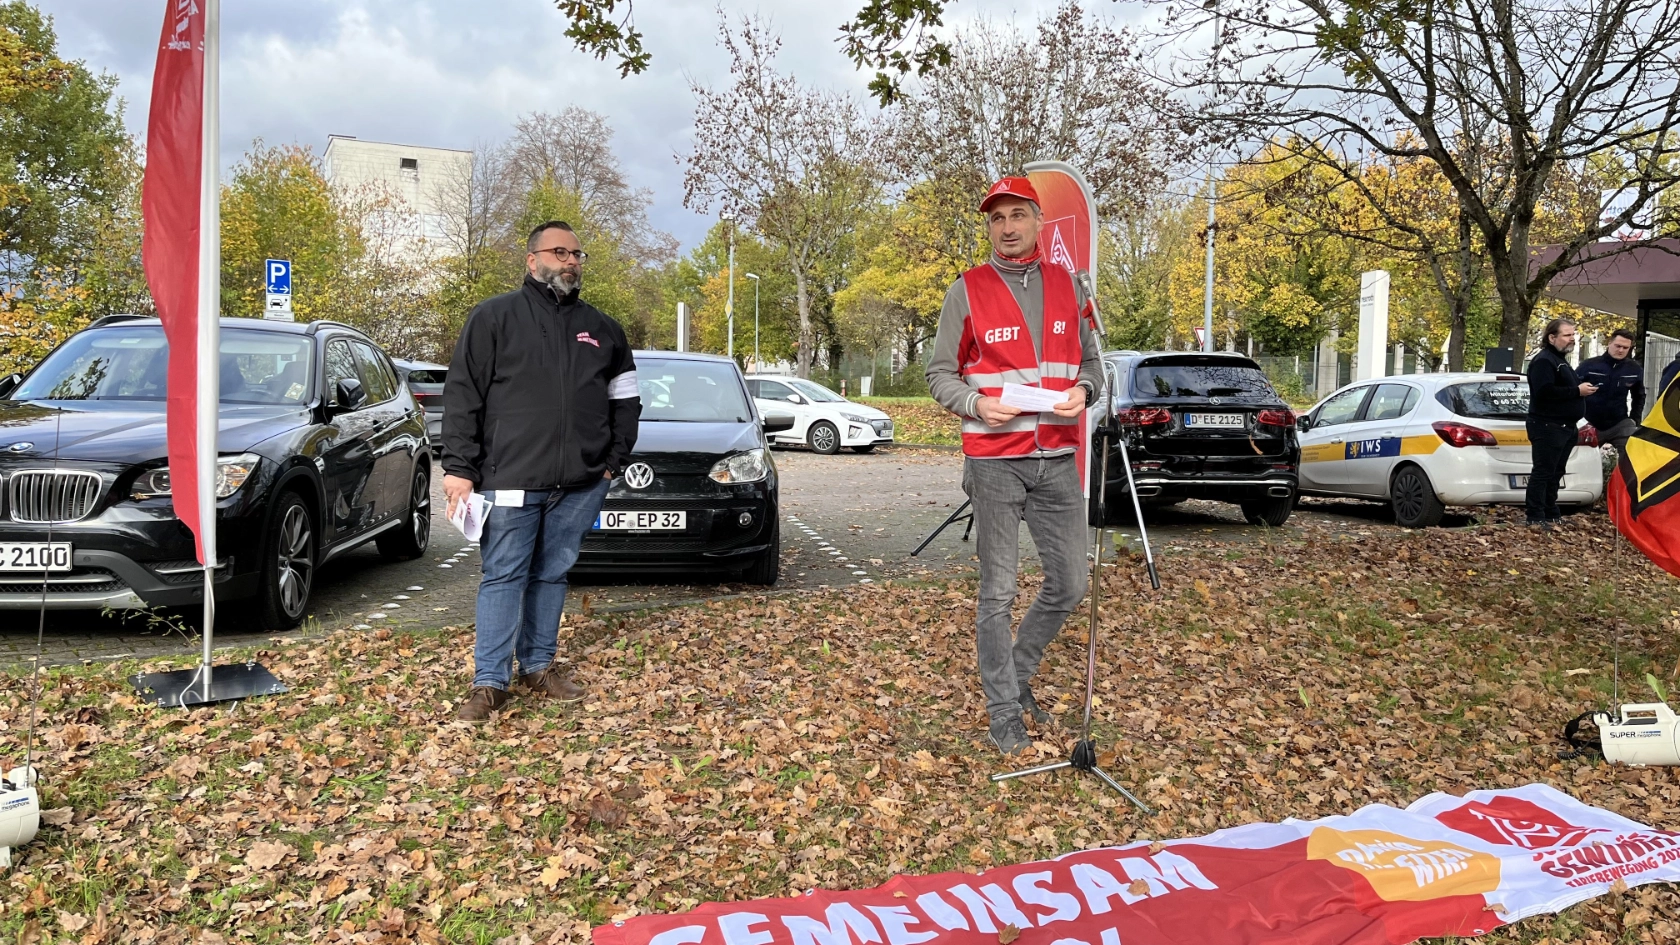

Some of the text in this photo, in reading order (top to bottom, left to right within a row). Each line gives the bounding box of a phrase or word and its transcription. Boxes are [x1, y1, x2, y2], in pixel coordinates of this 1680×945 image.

[270, 263, 286, 283] P
[984, 320, 1066, 344] GEBT 8!
[1191, 415, 1242, 425] D EE 2125
[1360, 439, 1381, 454] IWS
[606, 512, 681, 527] OF EP 32
[11, 547, 68, 567] 2100
[1609, 731, 1636, 739] SUPER
[1566, 856, 1659, 887] TARIFBEWEGUNG
